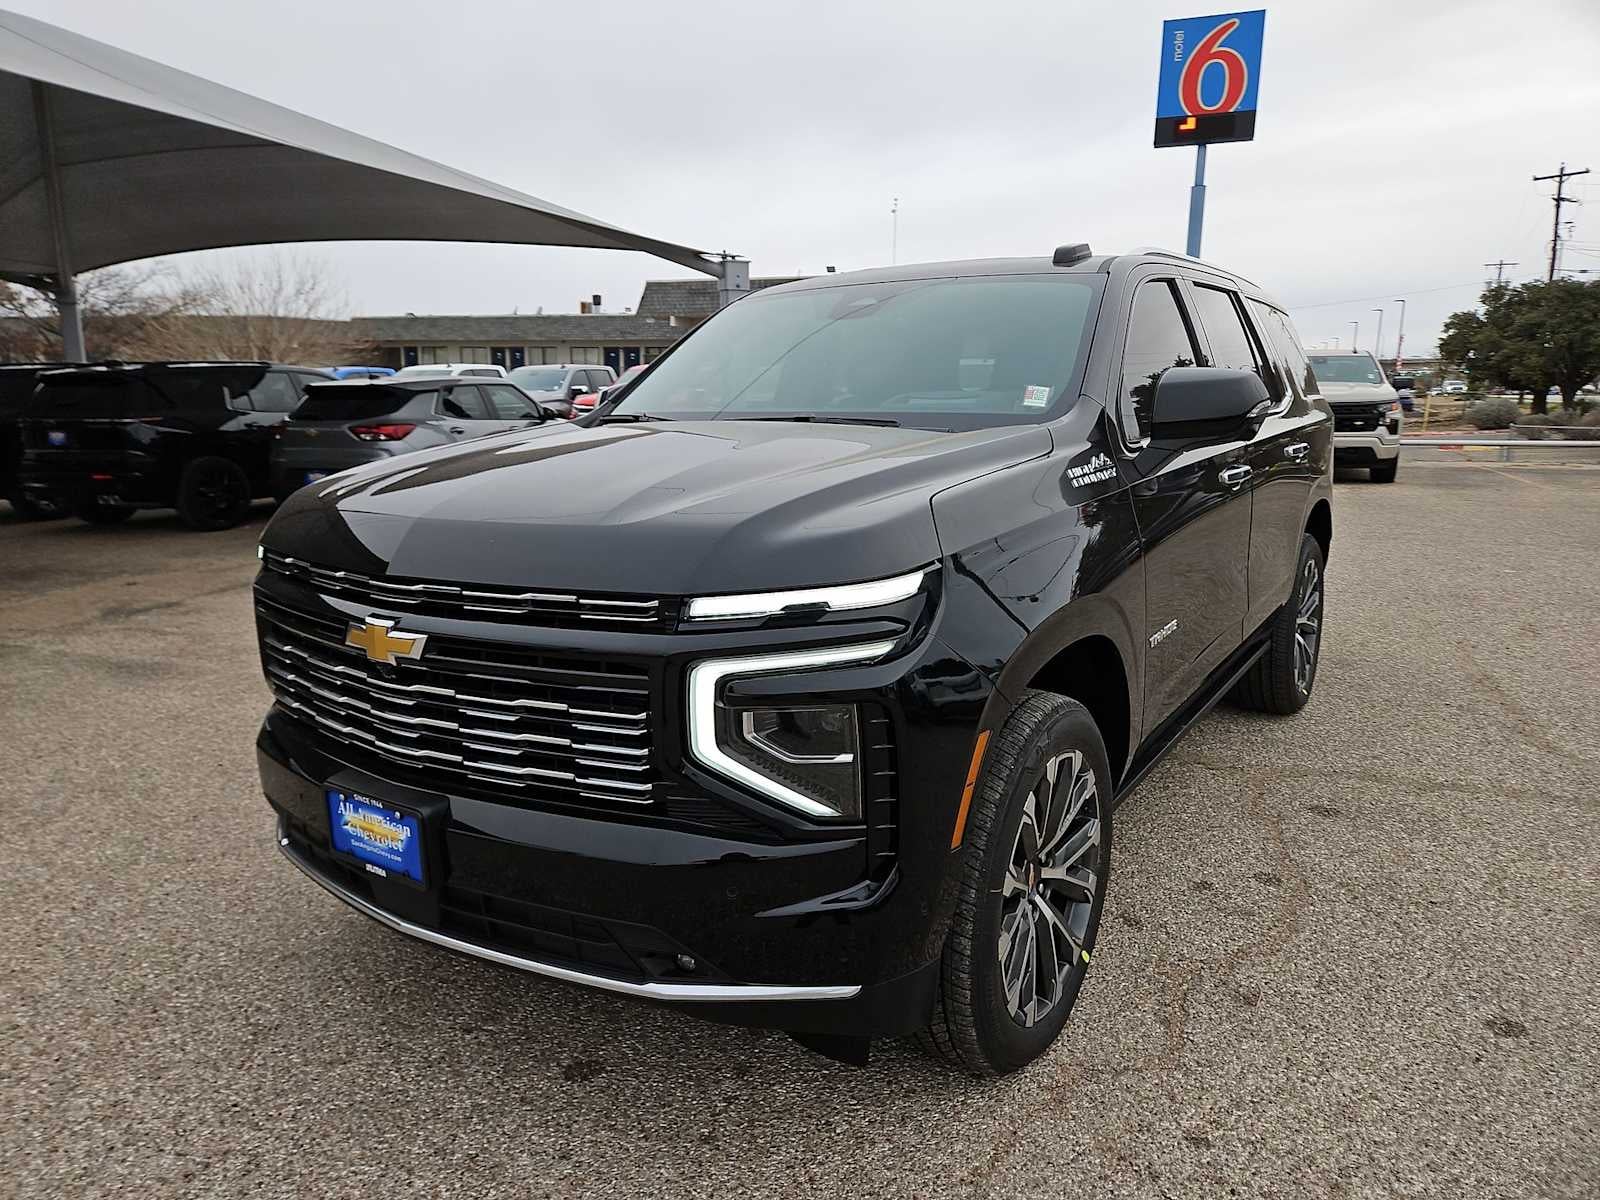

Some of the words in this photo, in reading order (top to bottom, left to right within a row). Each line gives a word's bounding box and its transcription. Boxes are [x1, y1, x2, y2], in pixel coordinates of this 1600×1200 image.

[1174, 30, 1185, 62] motel
[1179, 18, 1248, 116] 6
[347, 822, 404, 852] Chevrolet
